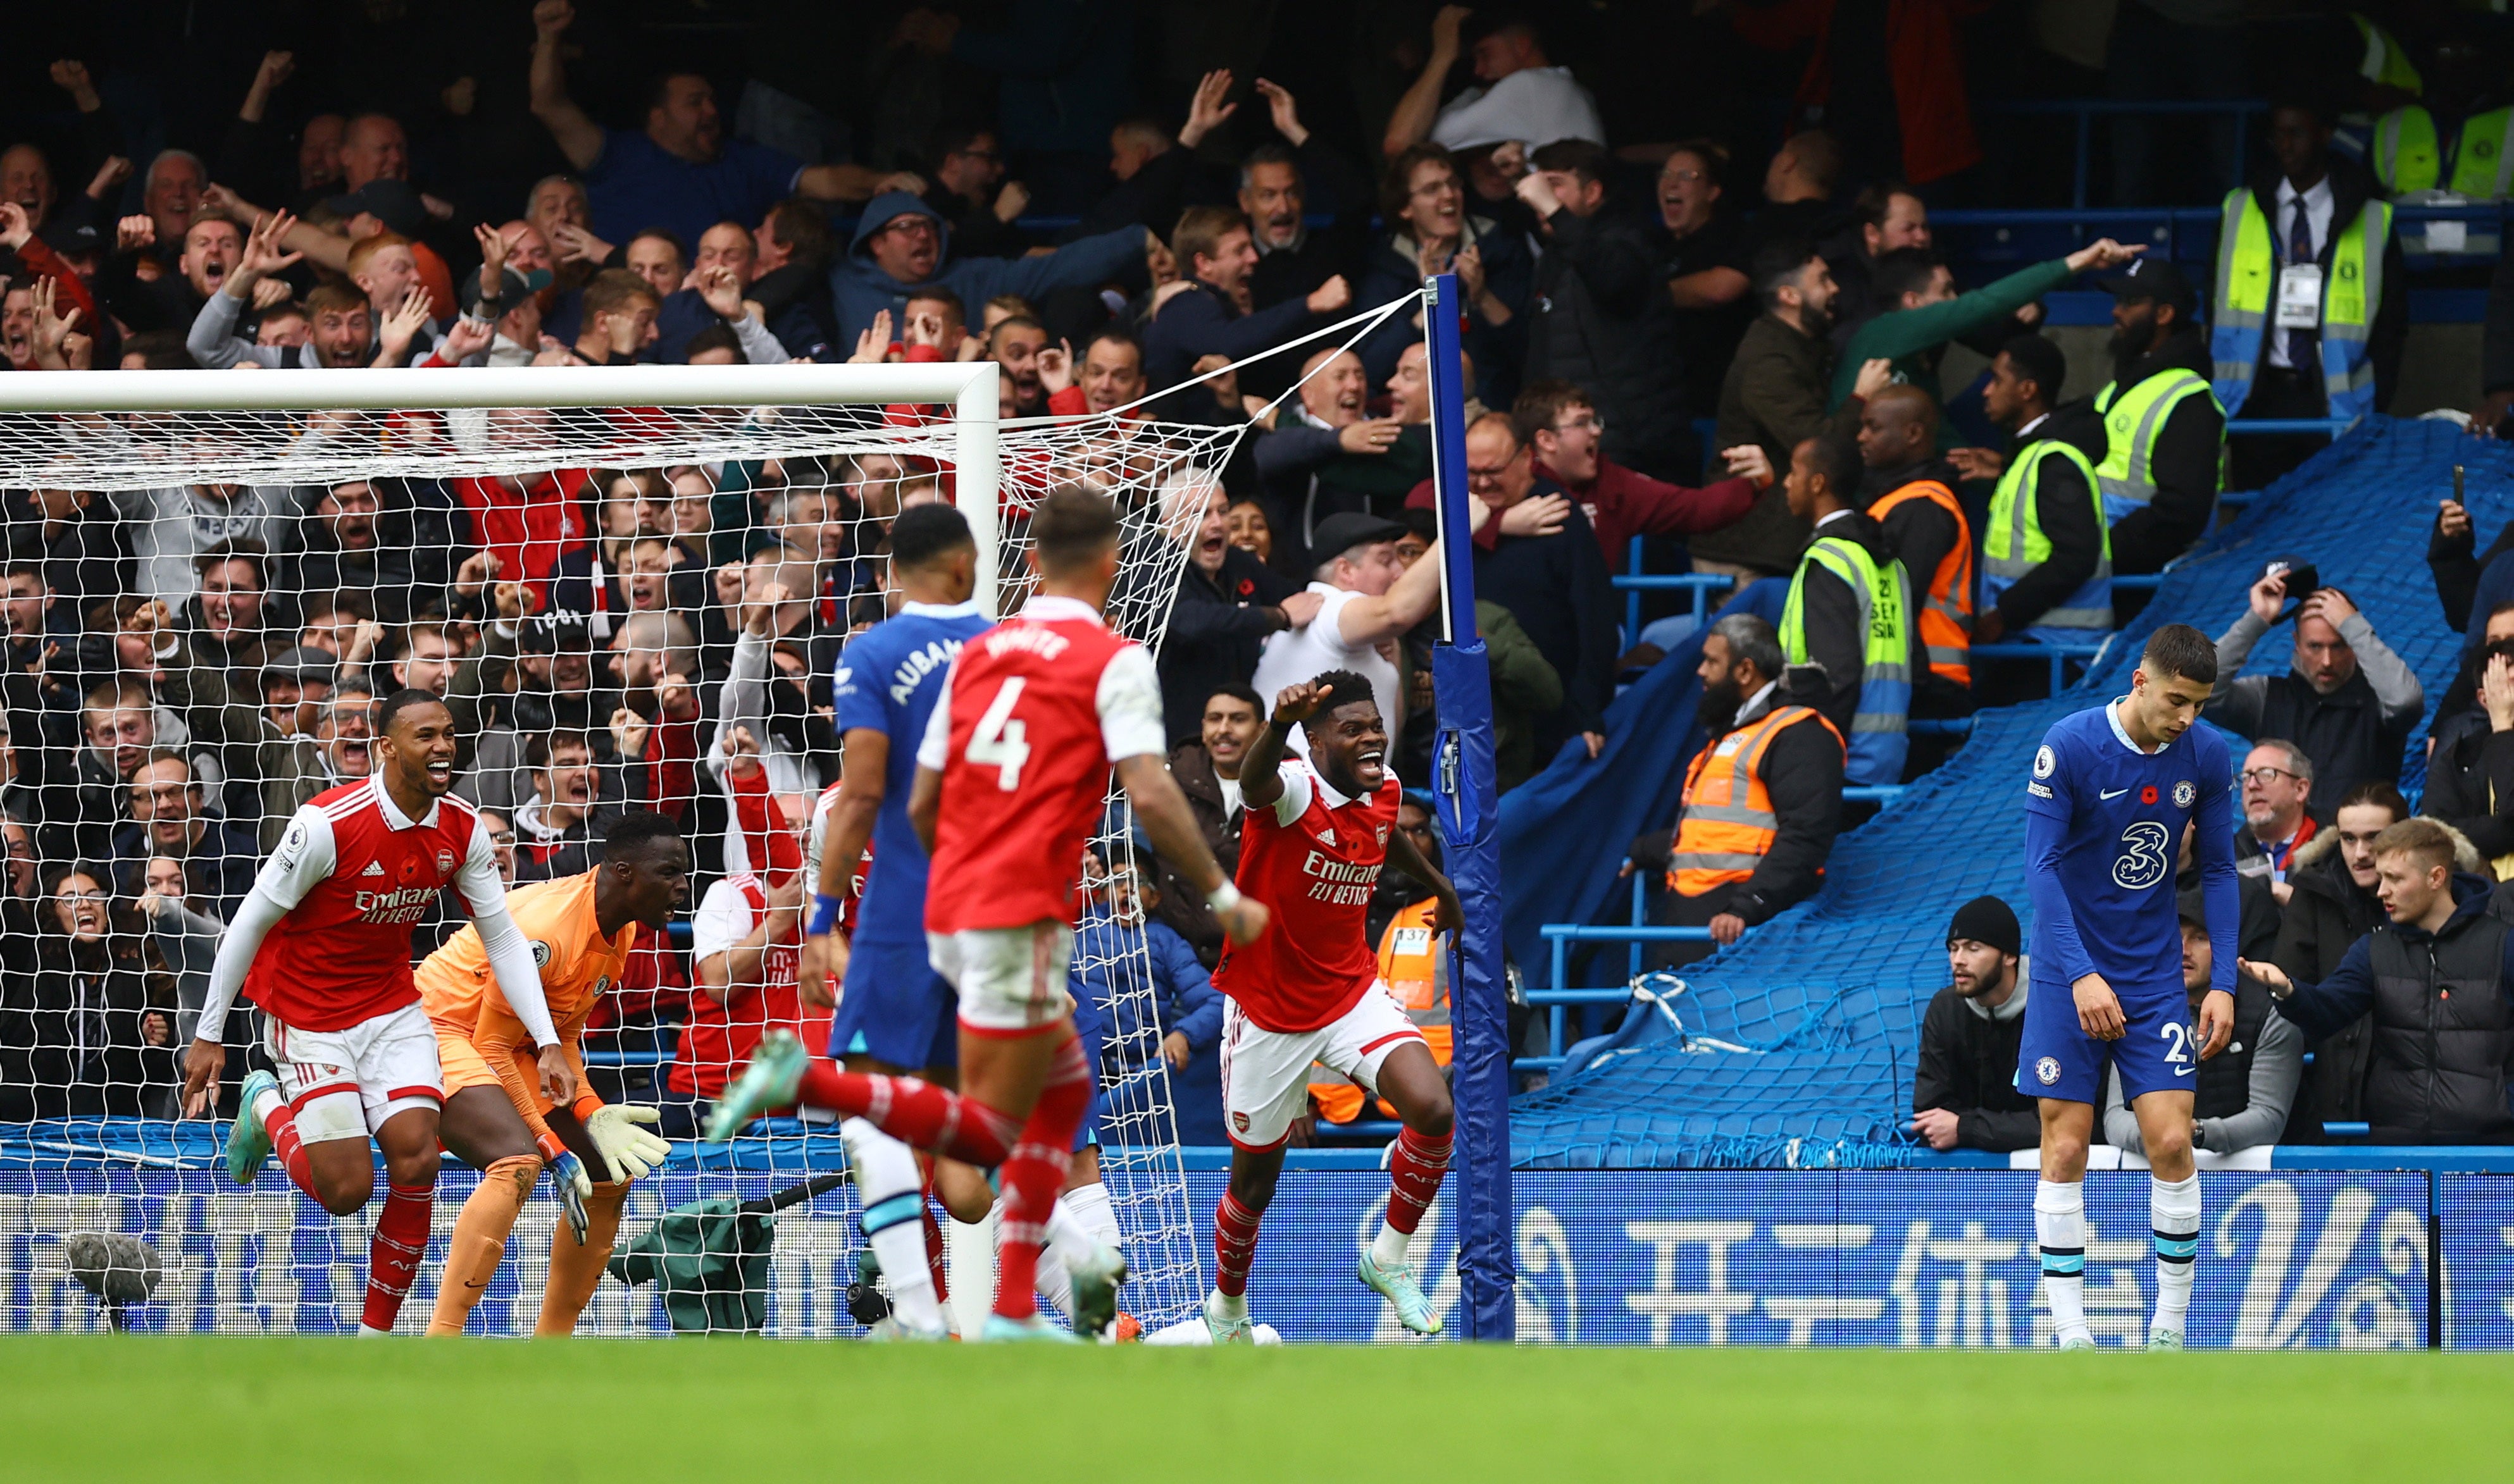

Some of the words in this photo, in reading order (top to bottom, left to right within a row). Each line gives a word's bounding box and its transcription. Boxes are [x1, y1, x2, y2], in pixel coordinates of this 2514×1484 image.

[964, 676, 1031, 793] 4
[1307, 881, 1335, 901] FLY
[361, 909, 389, 924] FLY
[1397, 929, 1428, 941] 137
